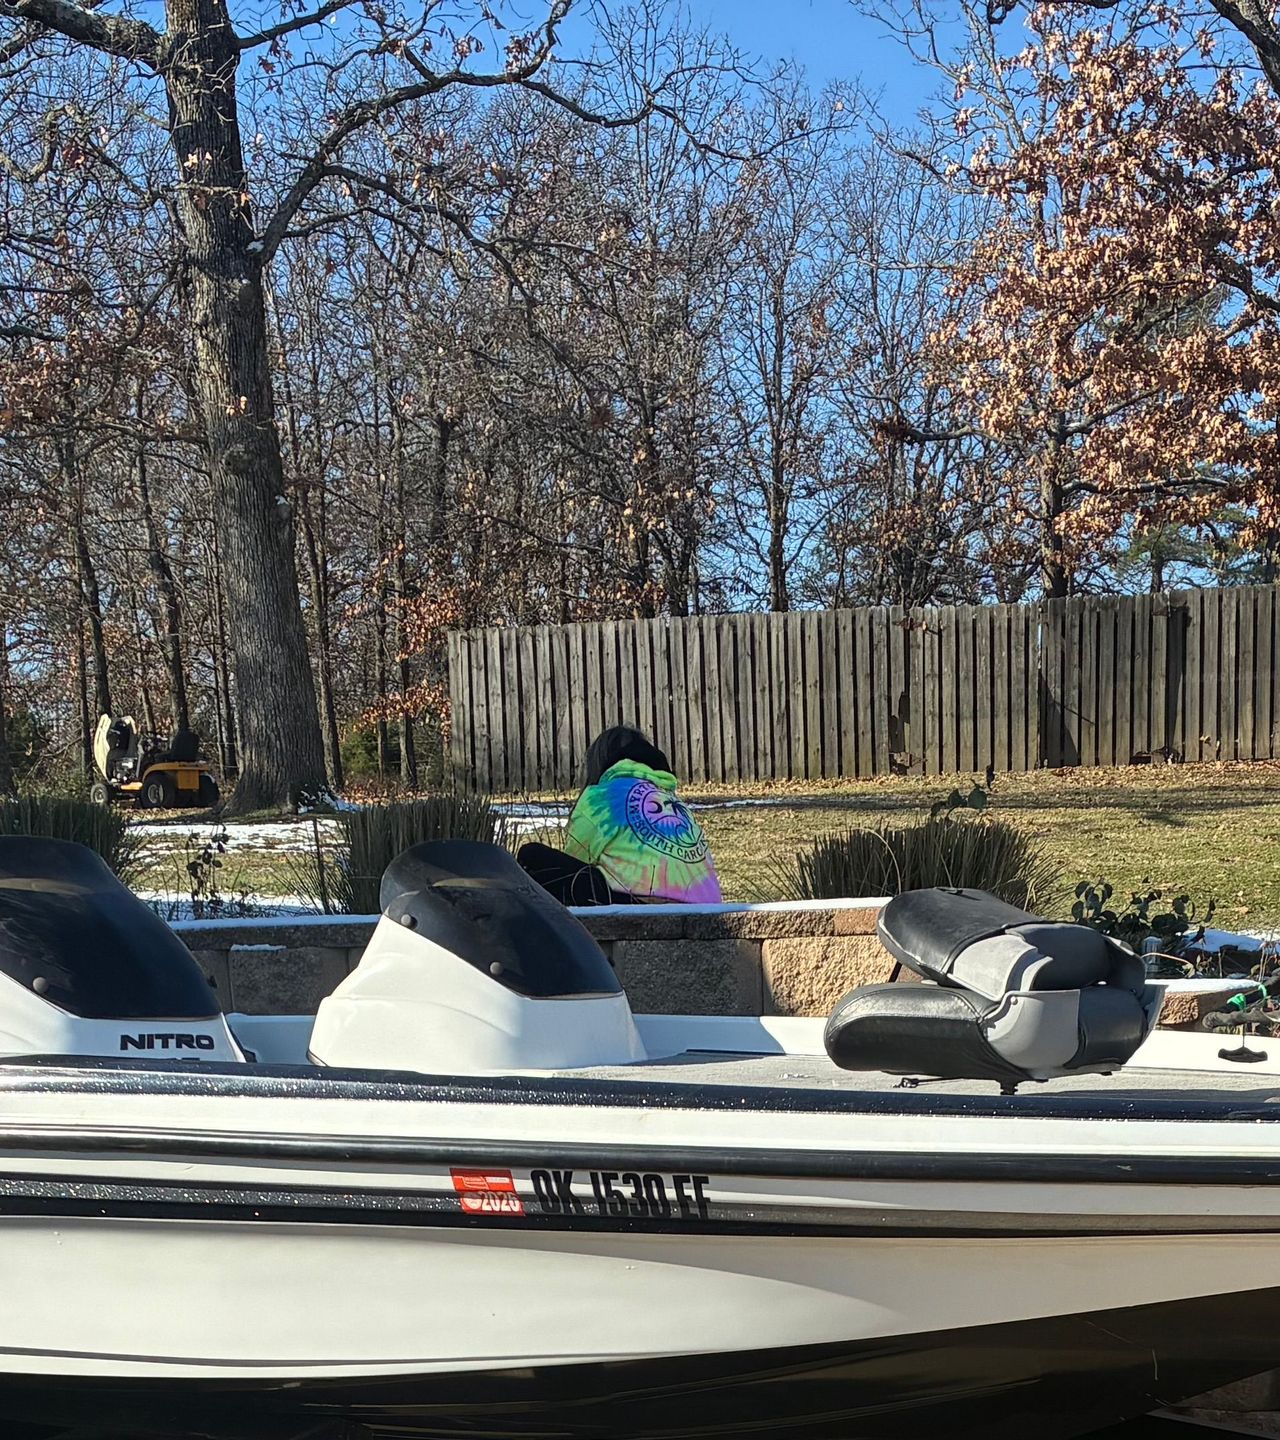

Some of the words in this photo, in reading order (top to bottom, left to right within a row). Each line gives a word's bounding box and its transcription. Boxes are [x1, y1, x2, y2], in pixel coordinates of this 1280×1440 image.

[634, 820, 675, 853] SOUTH
[120, 1034, 215, 1050] NITRO
[531, 1169, 586, 1214] OK
[590, 1171, 671, 1217] 1530
